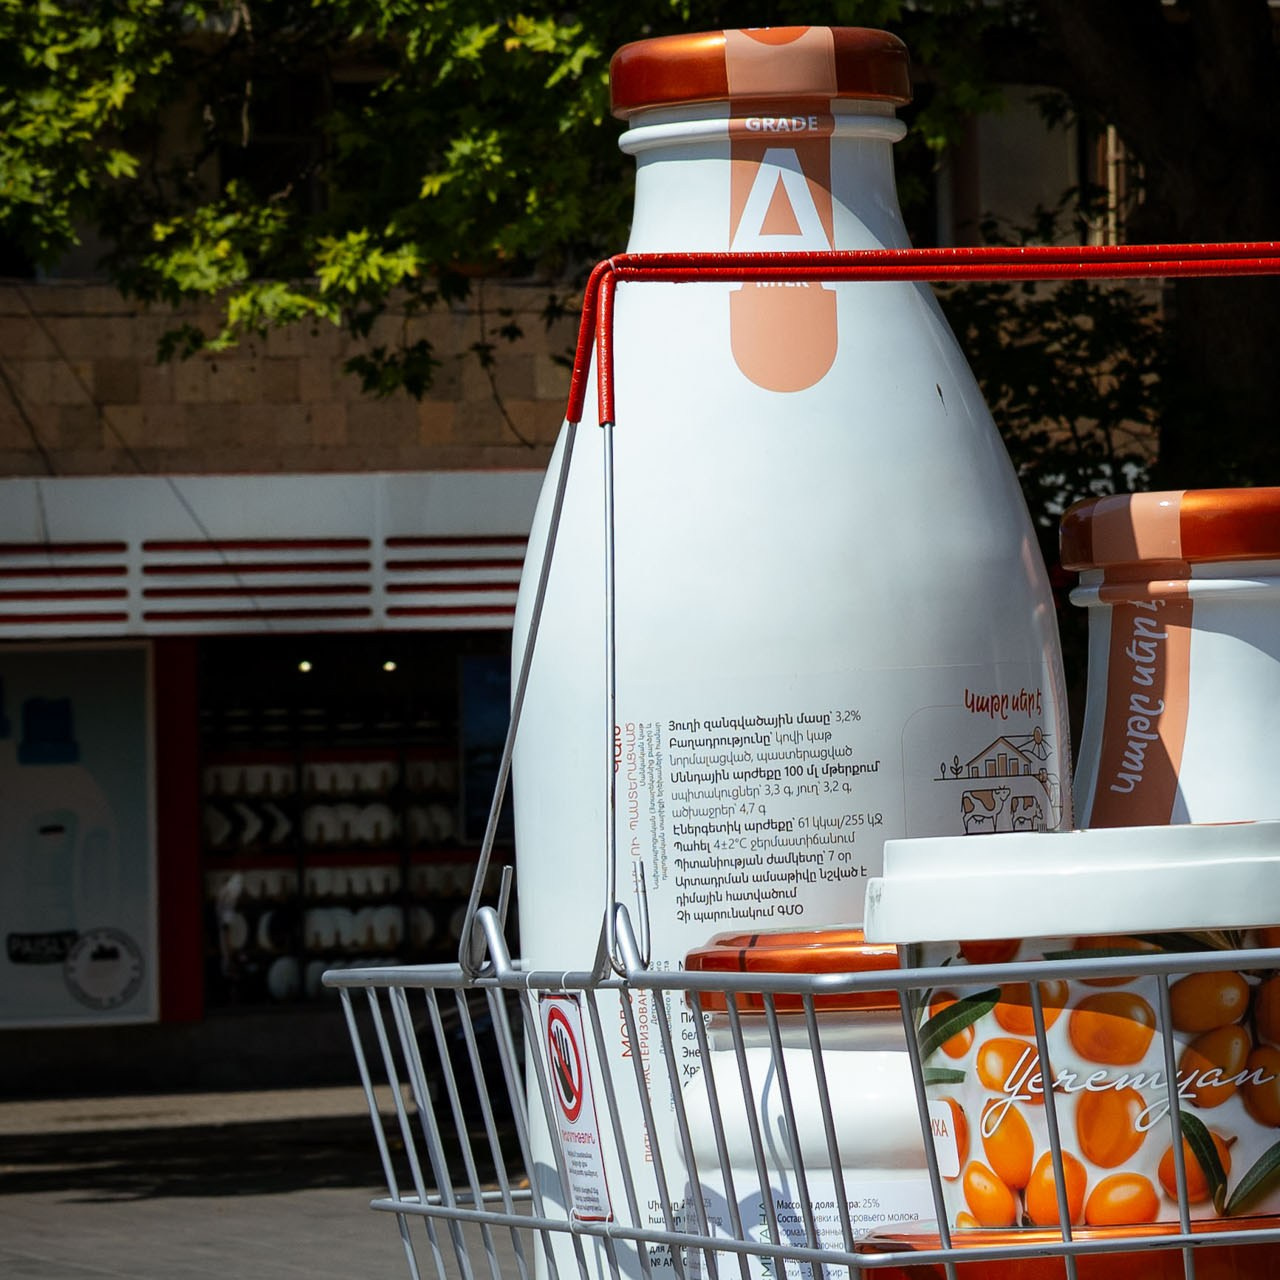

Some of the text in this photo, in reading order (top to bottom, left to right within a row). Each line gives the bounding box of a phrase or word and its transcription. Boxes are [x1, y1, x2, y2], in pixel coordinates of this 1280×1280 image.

[744, 116, 819, 132] GRADE
[964, 688, 1009, 720] Կաթը
[668, 719, 701, 733] Յուղի
[703, 714, 793, 731] զանգվածային
[835, 709, 862, 722] 3,2%
[775, 730, 804, 745] կովի
[807, 729, 832, 743] կաթ
[757, 745, 853, 763] պաստերացված
[670, 761, 880, 785] Սննդային արժեքը 100 մլ մթերքում
[764, 784, 780, 796] 3,3
[823, 780, 840, 794] 3,2
[739, 802, 756, 816] 4,7
[673, 819, 741, 836] Էներգետիկ
[797, 816, 810, 828] 61
[674, 837, 711, 854] Պահել
[750, 832, 856, 852] ջերմաստիճանում
[674, 854, 763, 872] Պիտանիության
[827, 850, 835, 862] 7
[837, 850, 852, 864] օր
[675, 871, 749, 888] Արտադրման
[752, 867, 817, 884] ամսաթիվը
[819, 867, 858, 882] նշված
[676, 887, 798, 907] դիմային հատվածում
[676, 903, 804, 922] Չի պարունակում ԳՄՕ
[980, 1047, 1276, 1138] Yeremyan
[815, 1200, 835, 1211] доля
[861, 1197, 880, 1208] 25%
[848, 1212, 886, 1224] оровьего
[887, 1212, 919, 1221] молока
